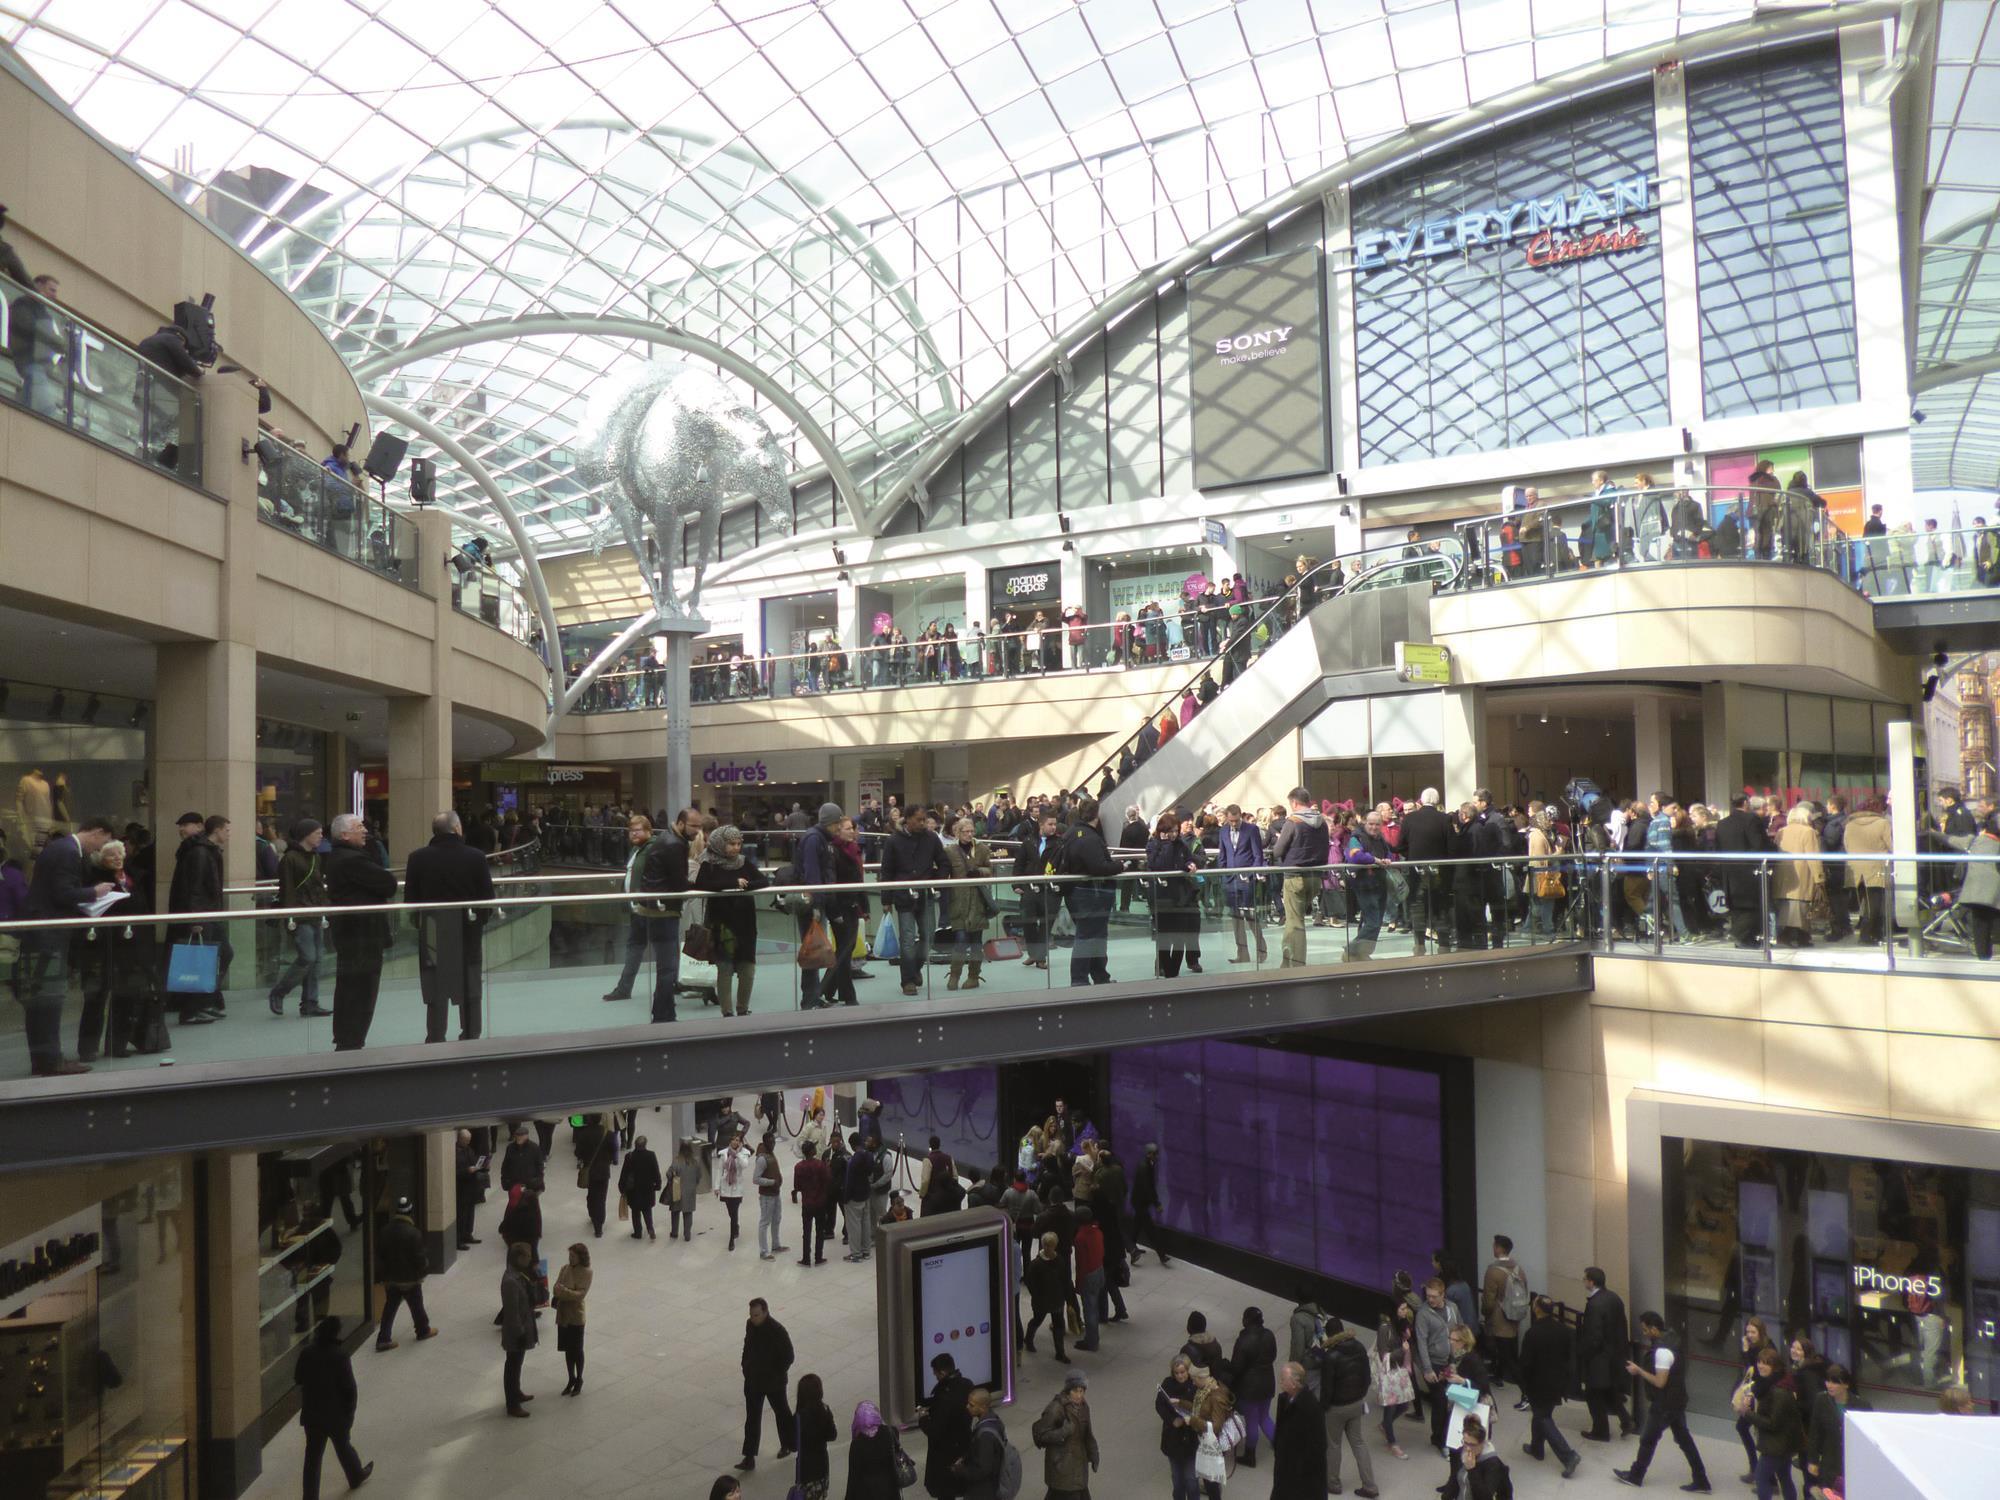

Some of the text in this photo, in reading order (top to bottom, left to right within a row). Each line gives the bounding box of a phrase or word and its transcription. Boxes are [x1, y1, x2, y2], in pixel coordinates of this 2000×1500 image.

[1355, 175, 1651, 270] EVERYMAN
[1526, 226, 1648, 267] Cinema
[1216, 326, 1293, 354] SONY
[1009, 573, 1049, 587] mamas
[1112, 584, 1154, 607] WEAR
